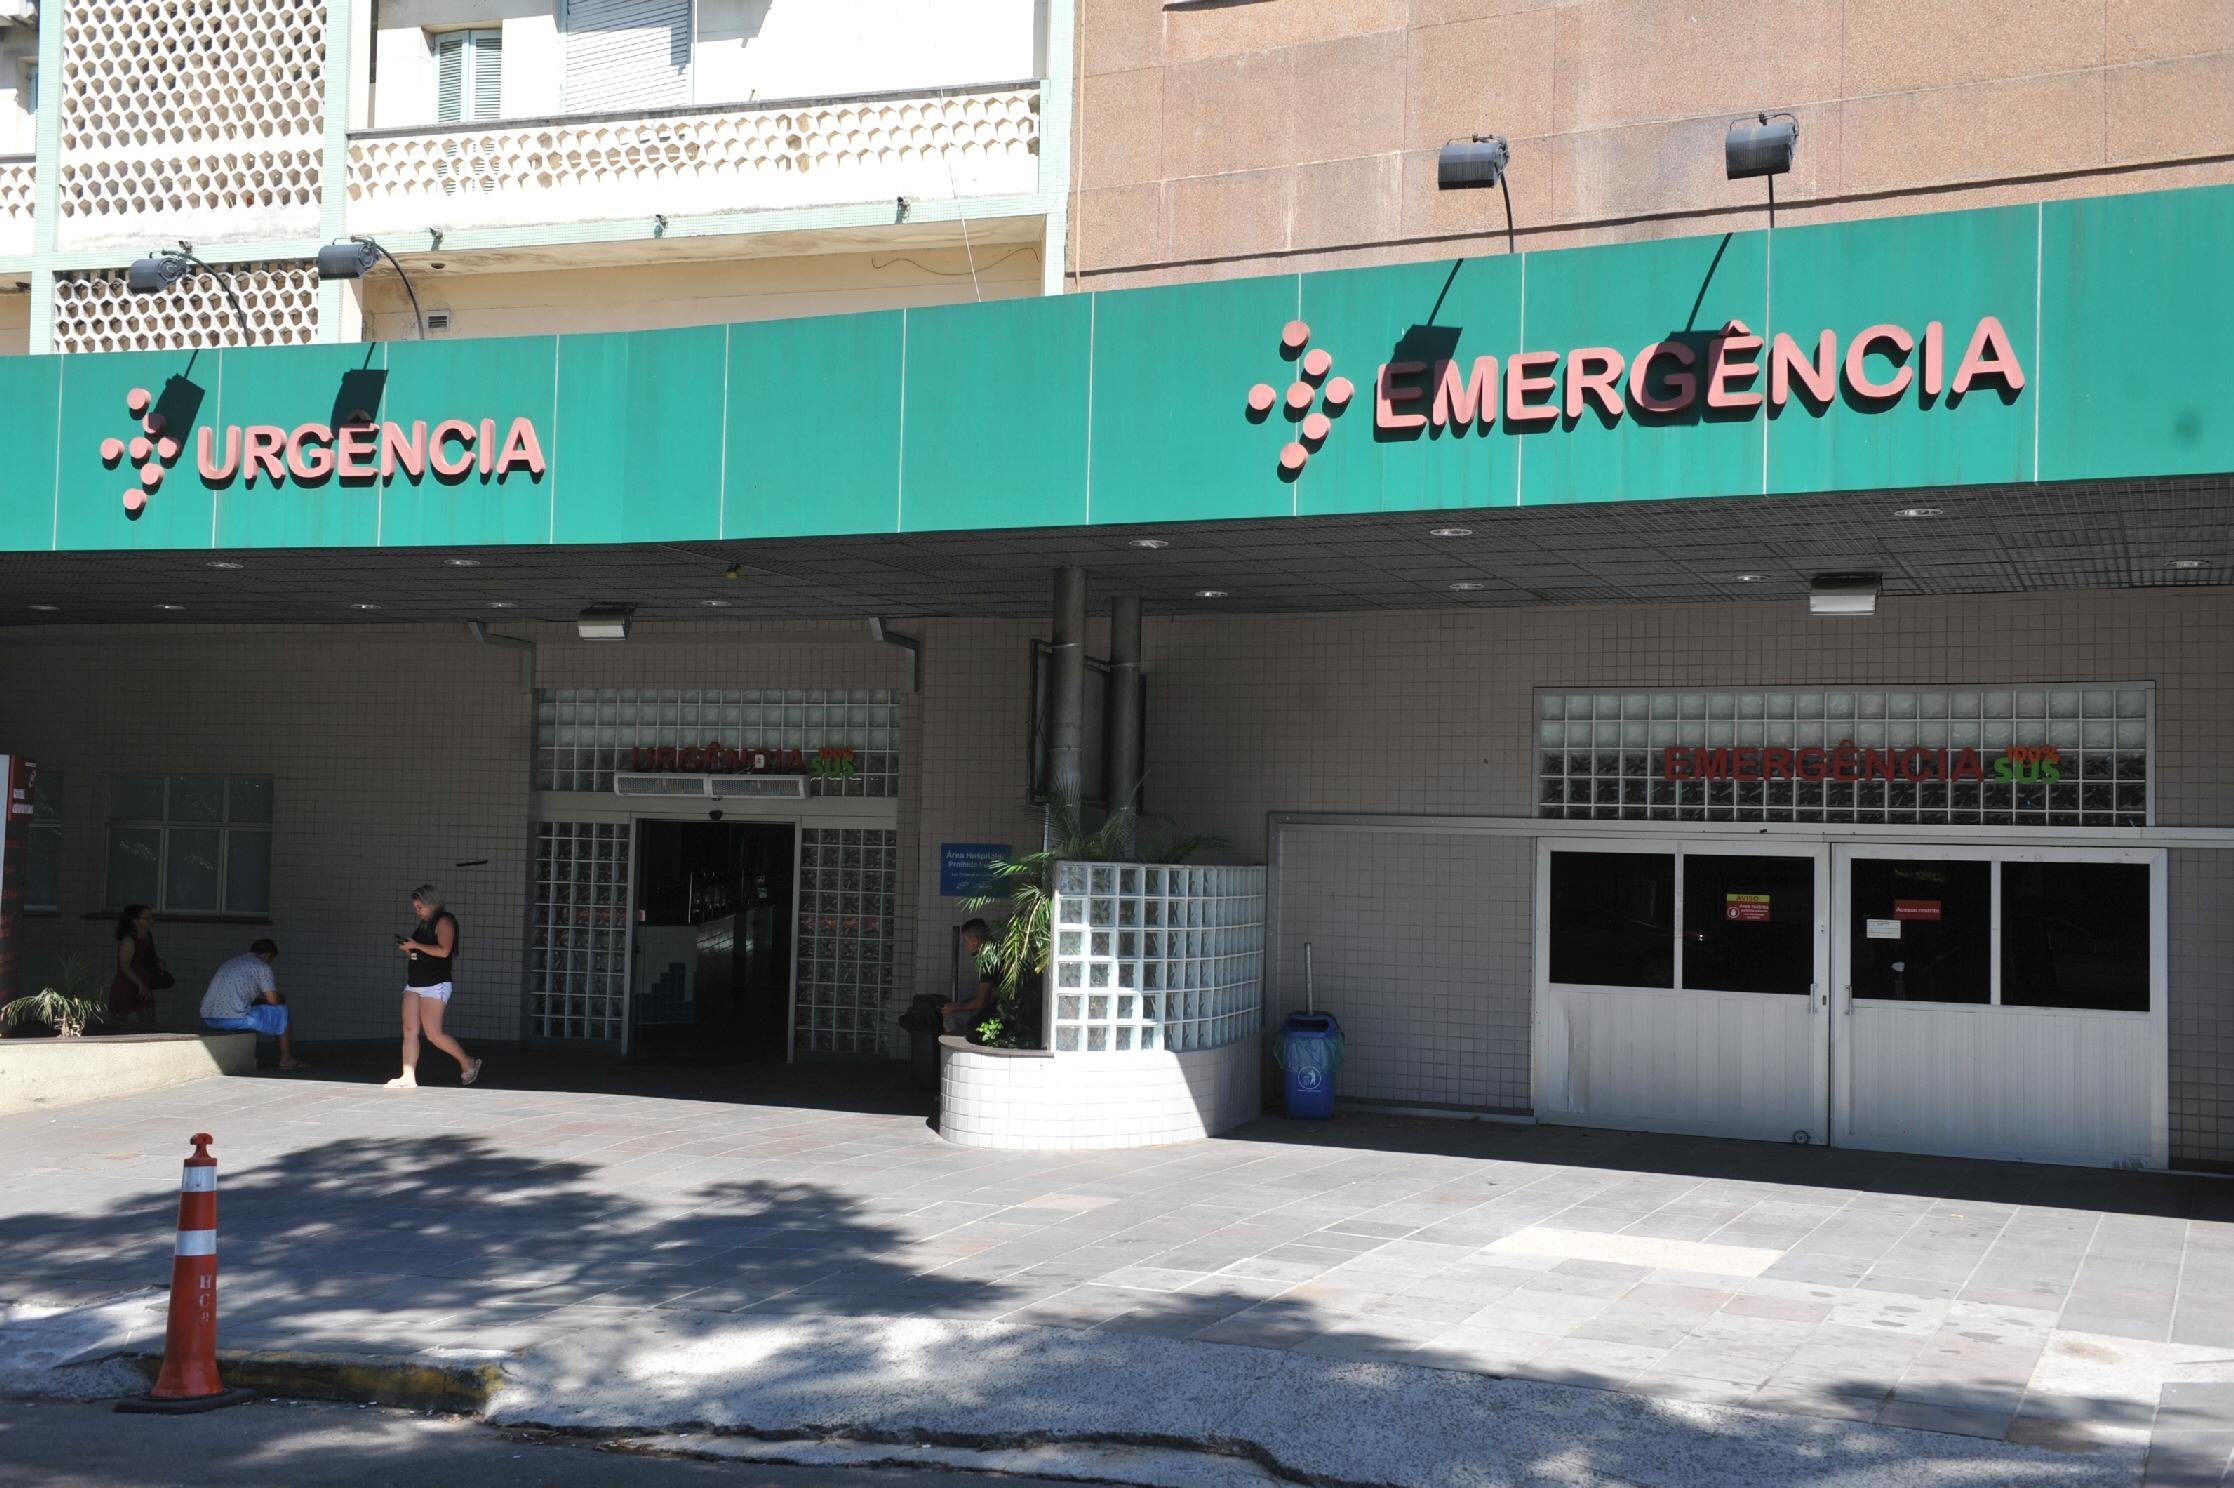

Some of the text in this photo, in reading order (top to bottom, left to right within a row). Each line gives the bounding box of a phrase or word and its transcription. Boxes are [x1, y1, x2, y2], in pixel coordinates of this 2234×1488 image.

[1376, 315, 2026, 430] EMERGÊNCIA
[196, 409, 547, 480] URGÊNCIA
[632, 741, 807, 773] URGÊNCIA
[810, 755, 855, 777] SUS
[1664, 739, 1985, 784] EMERGÊNCIA
[1994, 757, 2061, 785] SUS
[2005, 744, 2060, 766] 100%
